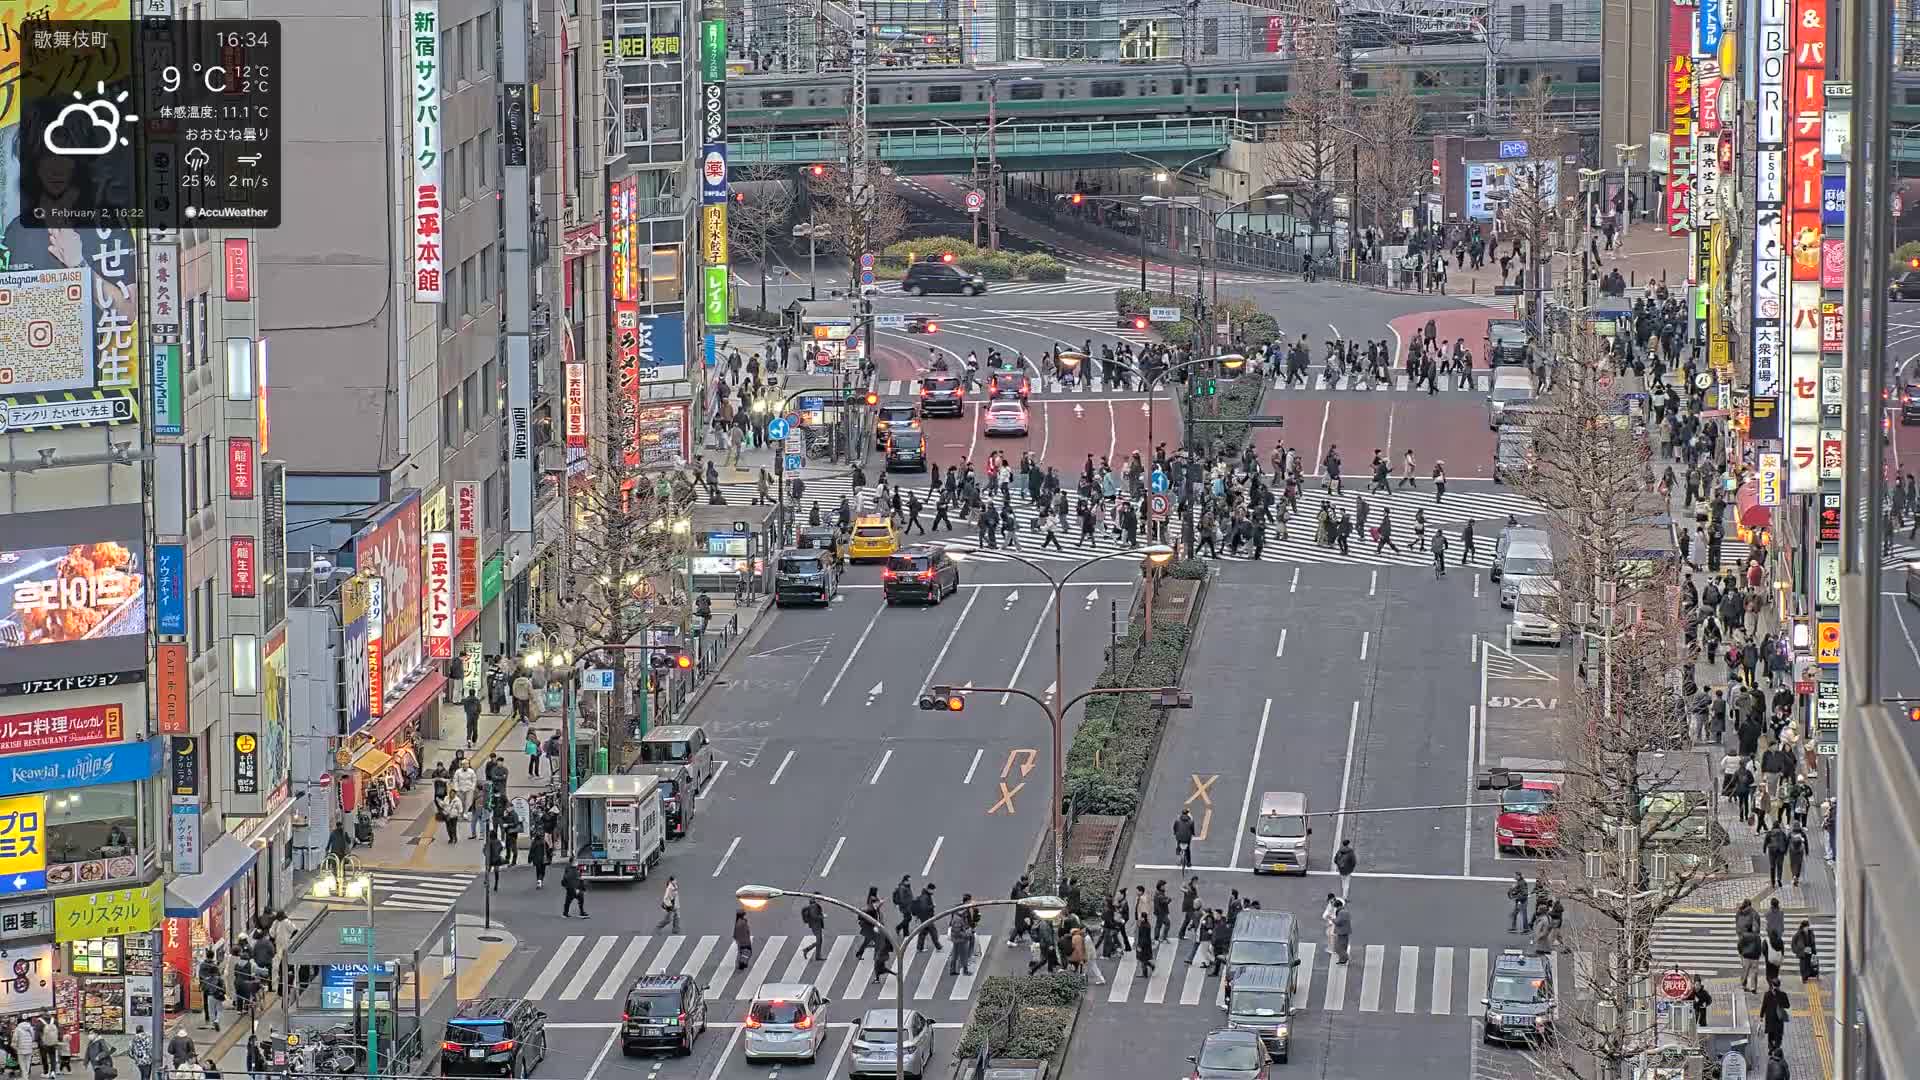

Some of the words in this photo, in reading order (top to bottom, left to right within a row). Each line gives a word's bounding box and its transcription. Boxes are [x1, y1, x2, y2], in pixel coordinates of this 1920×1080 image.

[652, 36, 680, 54] 夜間
[415, 12, 437, 170] 新宿サンパーク
[1704, 88, 1715, 120] アコム
[417, 184, 440, 292] 三平本館
[710, 208, 722, 263] 肉汁水餃子
[709, 276, 721, 313] レイク
[156, 325, 174, 335] 3F
[1757, 330, 1772, 382] 大衆酒場
[155, 353, 168, 415] FamilyMart
[1794, 307, 1818, 469] パセラ
[12, 409, 48, 422] テンクリ
[52, 405, 110, 418] たいせい先生
[512, 407, 528, 460] HOMEGAME
[234, 449, 248, 488] 龍生堂
[1826, 497, 1839, 505] 3F
[236, 547, 249, 583] 龍生堂
[431, 542, 448, 628] 三平ストア
[22, 676, 74, 695] リアエイド
[77, 672, 119, 691] ビジョン
[0, 716, 68, 739] ルコ料理
[23, 735, 68, 747] RESTAURANT
[607, 823, 632, 834] 物産
[3, 910, 38, 932] 囲碁
[68, 903, 141, 928] クリスタル
[327, 991, 341, 1004] 12
